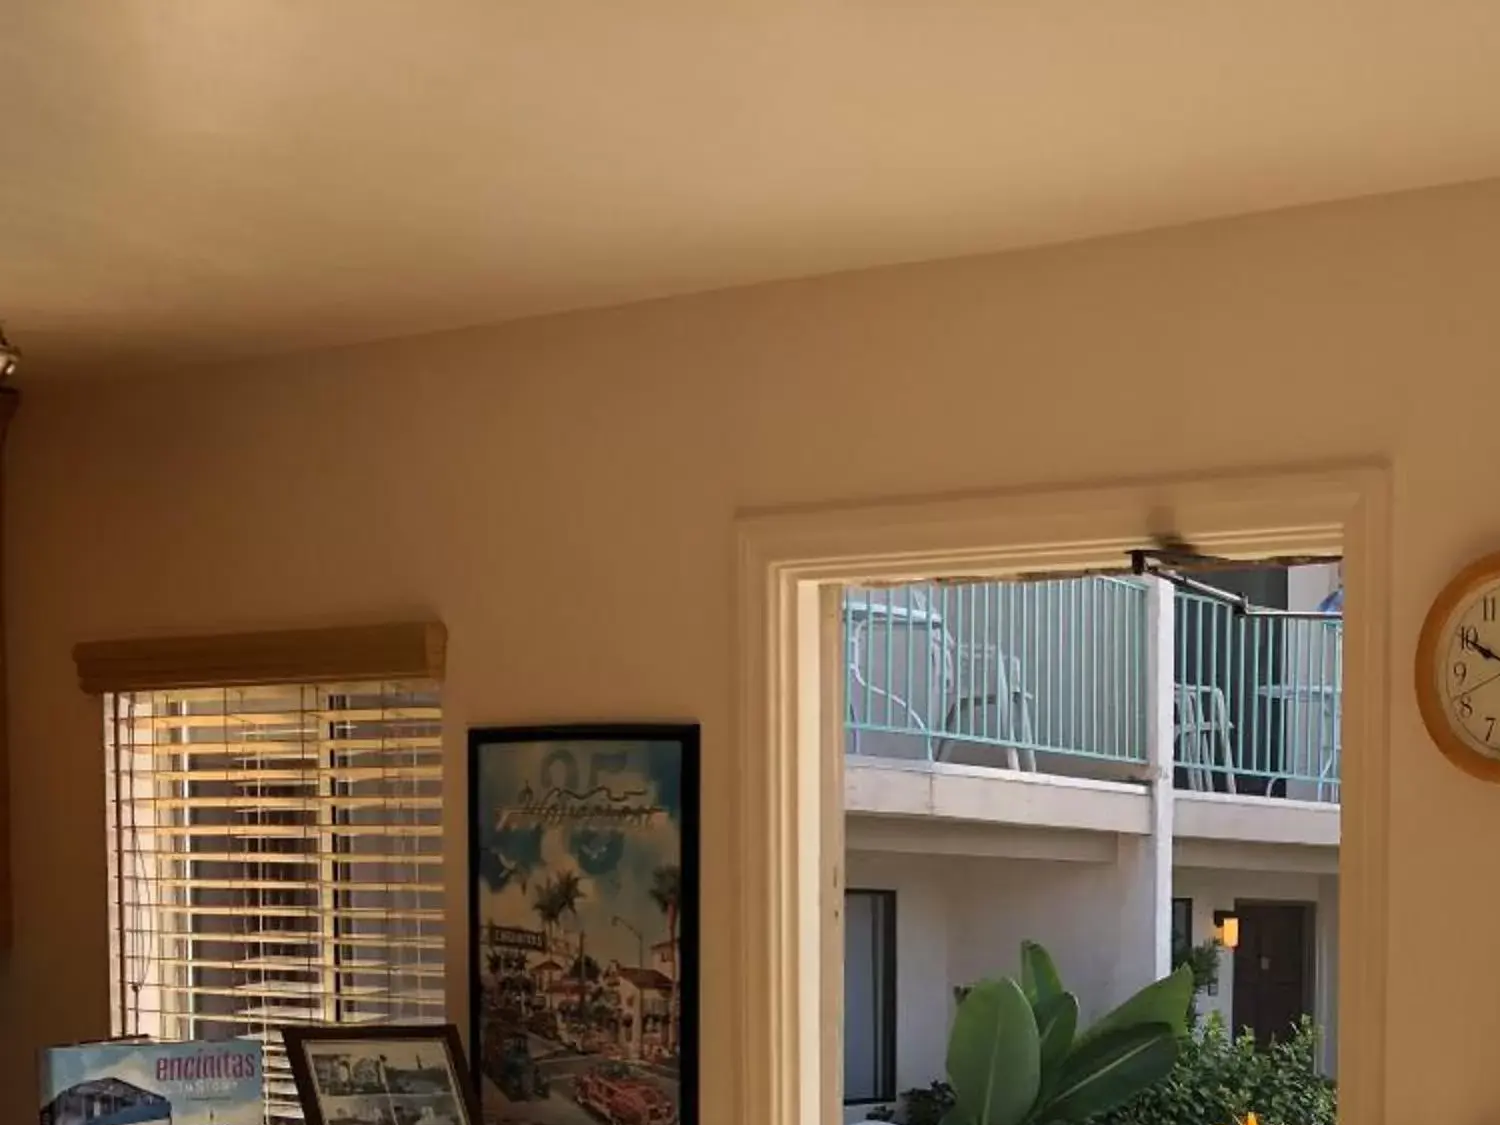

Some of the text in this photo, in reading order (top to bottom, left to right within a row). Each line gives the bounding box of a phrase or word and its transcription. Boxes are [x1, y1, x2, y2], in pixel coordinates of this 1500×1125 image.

[1483, 596, 1497, 622] 11
[1460, 626, 1479, 652] 10
[1453, 661, 1467, 685] 9
[1459, 695, 1473, 719] 8
[1485, 716, 1497, 742] 7
[156, 1050, 255, 1081] encinitas
